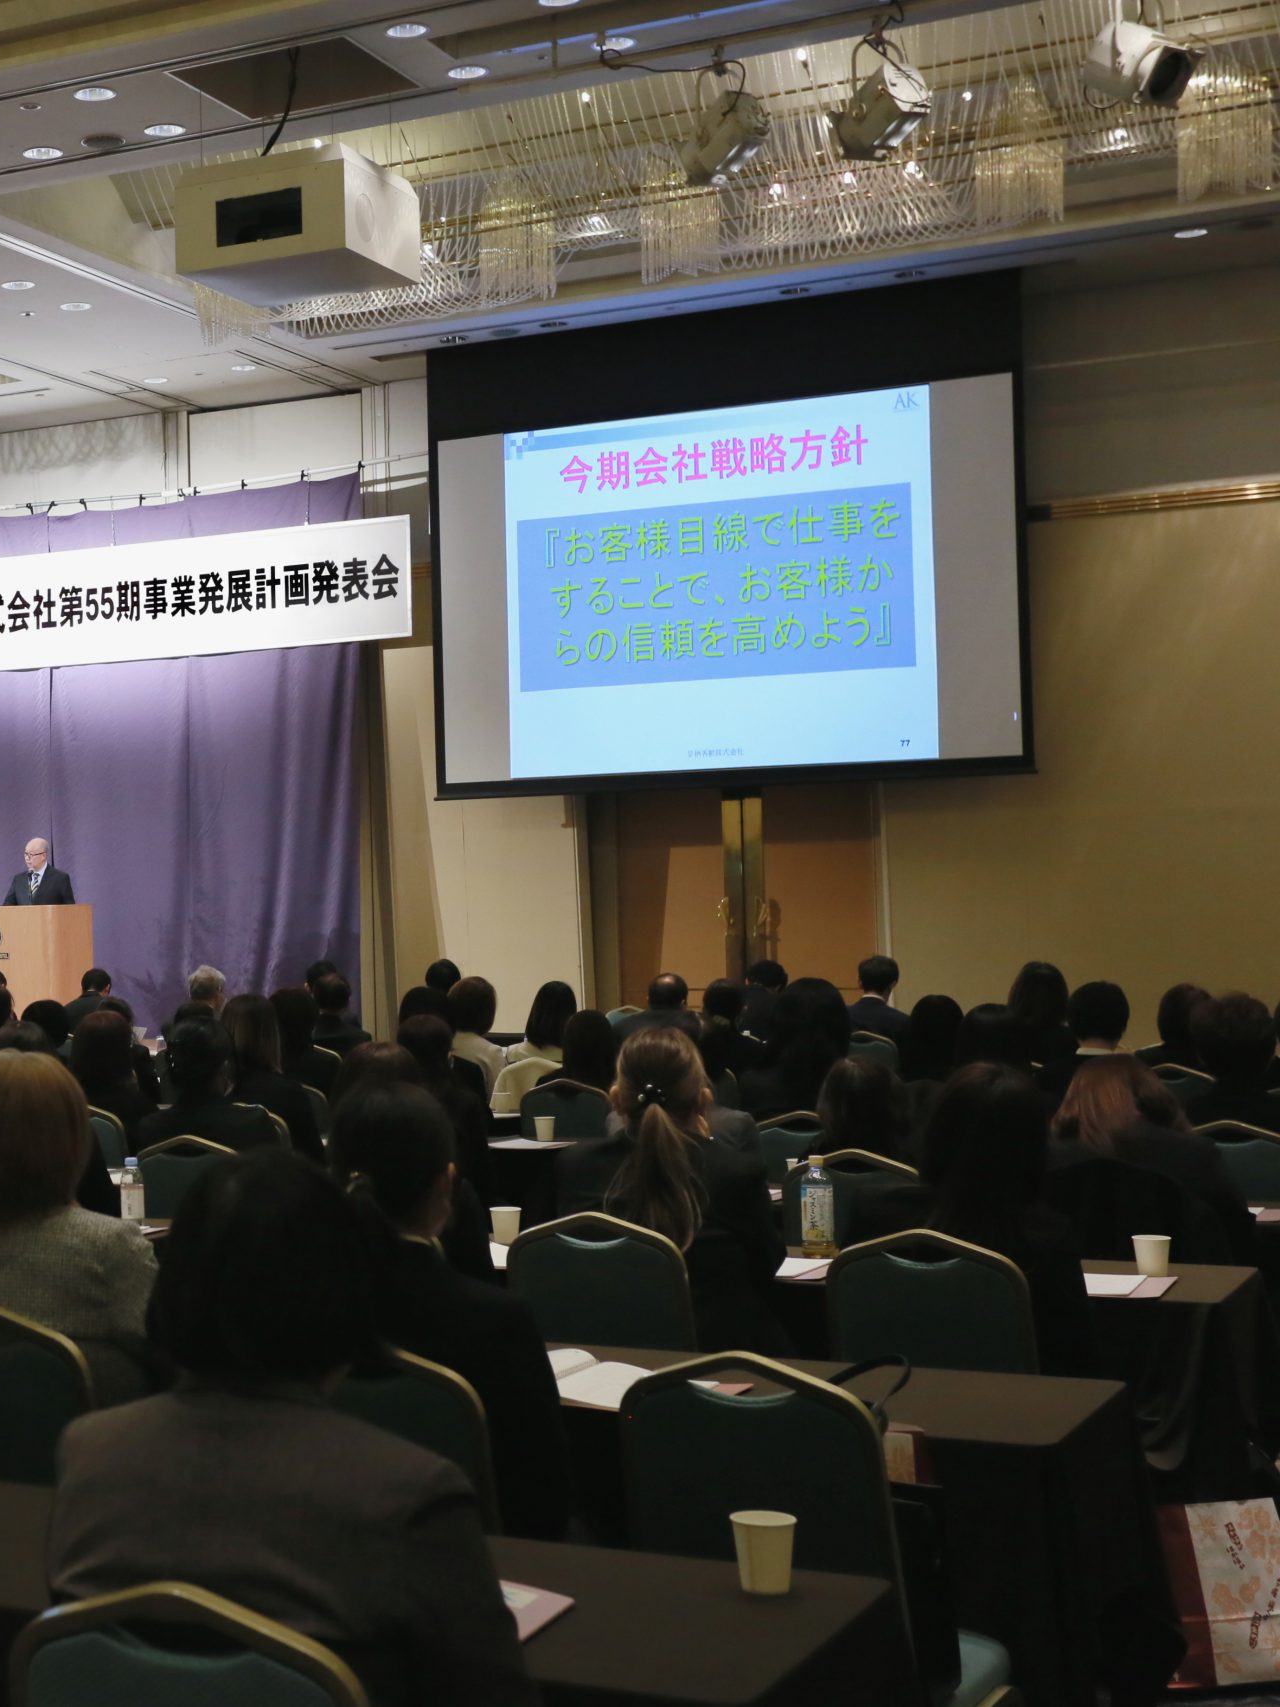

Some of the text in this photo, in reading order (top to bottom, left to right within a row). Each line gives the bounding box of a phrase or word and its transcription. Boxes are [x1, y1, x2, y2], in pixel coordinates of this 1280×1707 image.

[894, 391, 919, 409] AK
[559, 424, 868, 493] 今期会社戦略方針
[545, 497, 900, 568] 『お客様目線で仕事を
[550, 554, 893, 618] することで、お客様か
[555, 602, 891, 665] らの信頼を高めよう』
[900, 739, 910, 747] 77
